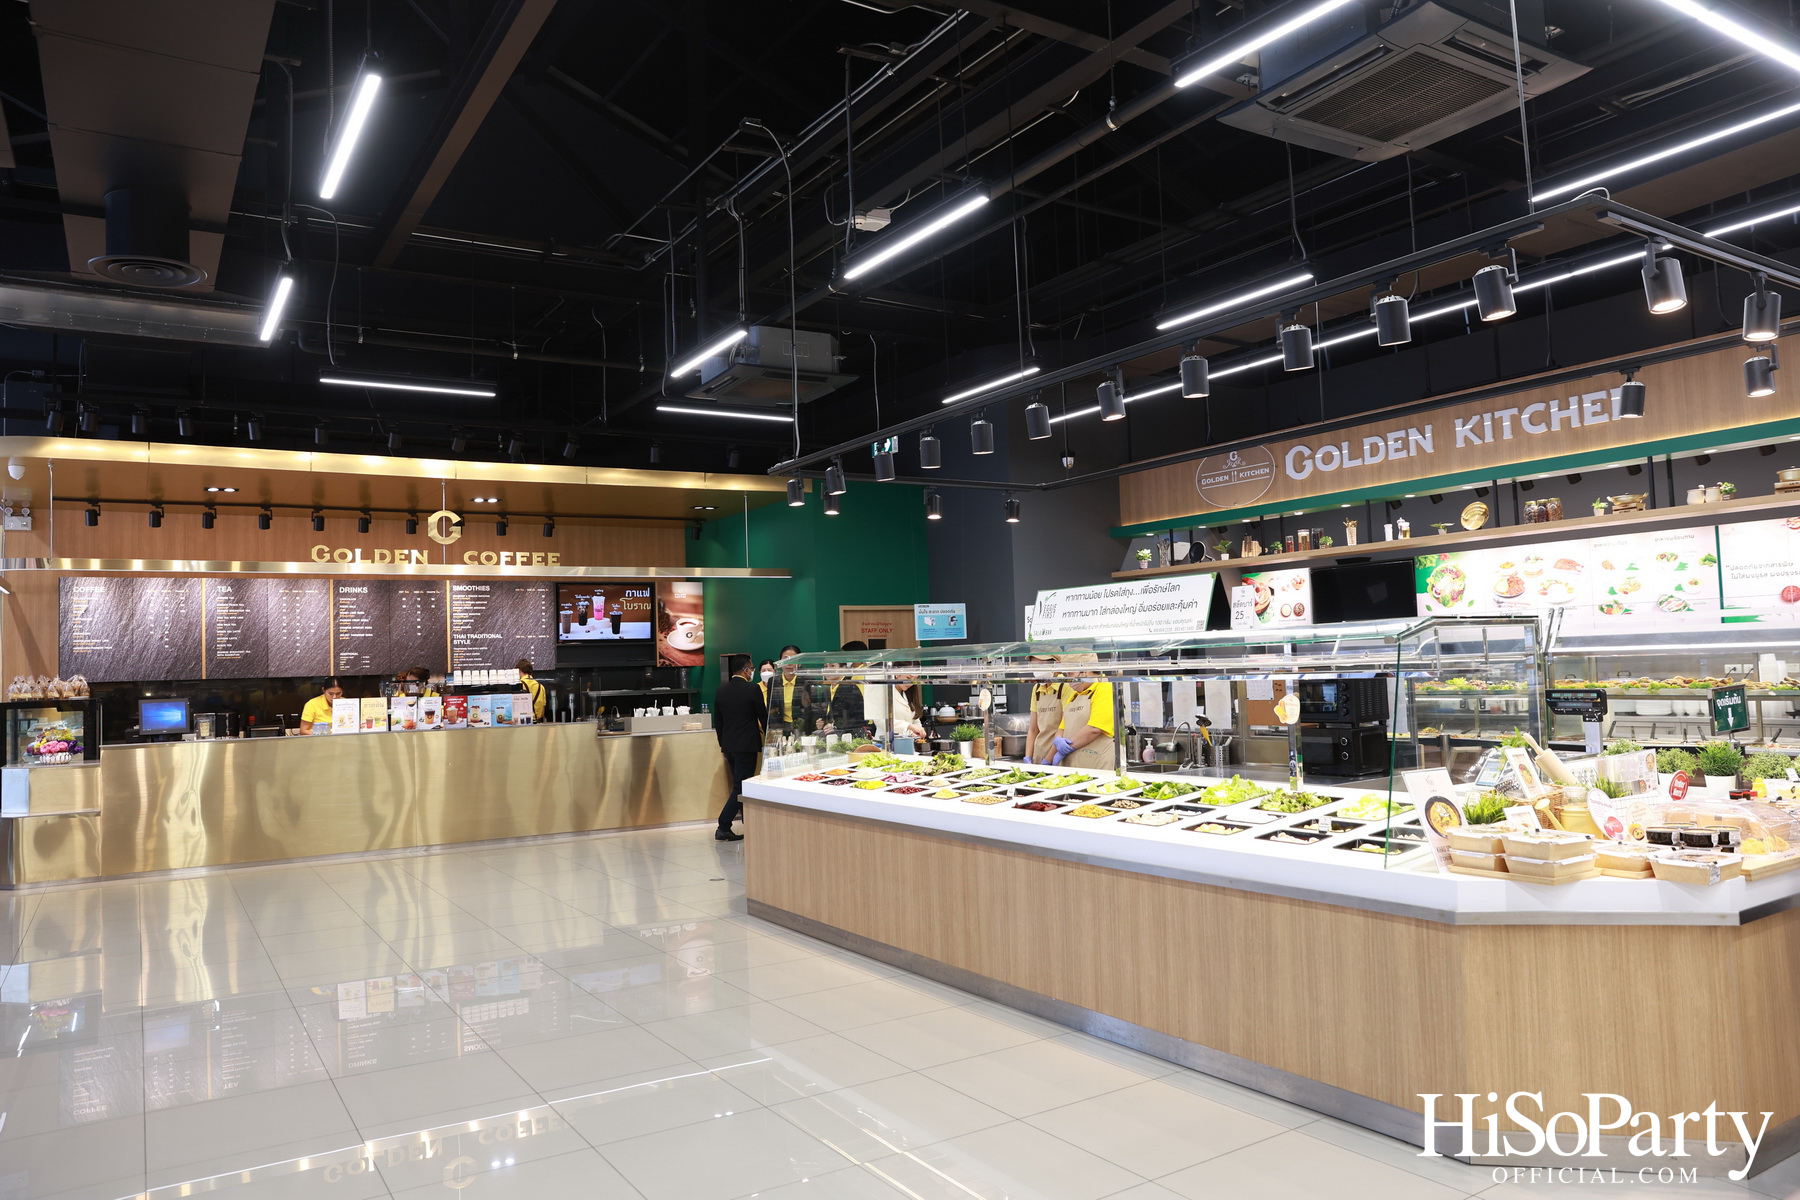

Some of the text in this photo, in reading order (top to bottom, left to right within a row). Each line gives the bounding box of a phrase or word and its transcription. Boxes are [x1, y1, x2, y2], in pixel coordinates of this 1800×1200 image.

[1285, 423, 1435, 481] GOLDEN
[1201, 467, 1270, 485] GOLDEN KITCHEN
[311, 544, 561, 567] GOLDEN COFFEE
[339, 586, 368, 594] DRINKS
[625, 587, 651, 598] กาแฟ
[1065, 589, 1103, 602] หากทานน้อย
[1062, 607, 1099, 618] หากทานมาก
[1099, 603, 1137, 616] ใส่กล่องใหญ่
[1235, 610, 1245, 620] 25
[1716, 691, 1742, 710] จุดเริ่มต้น
